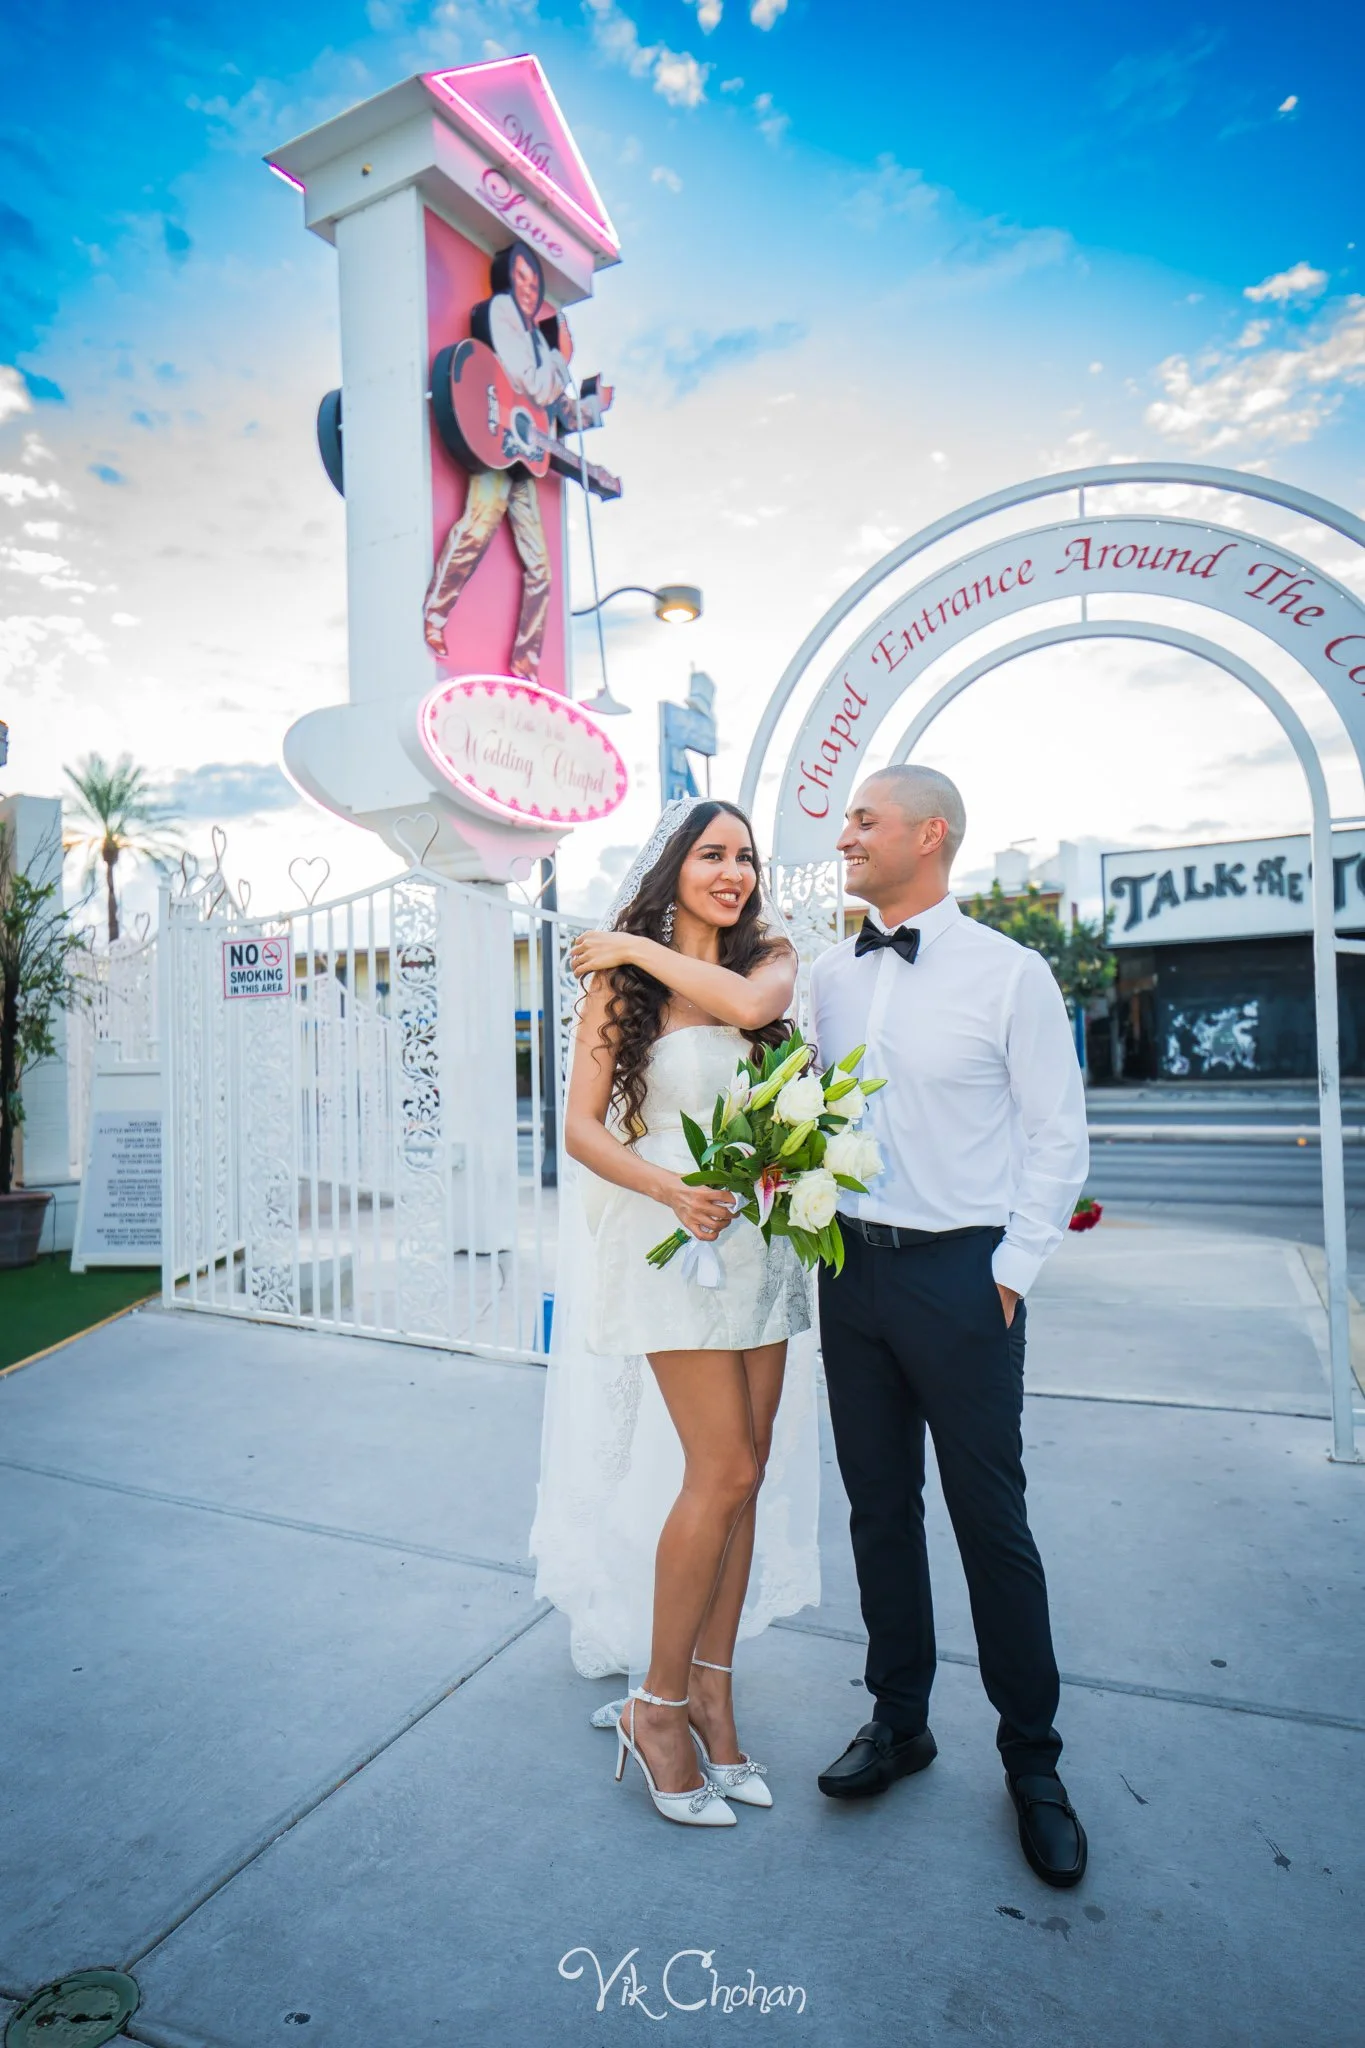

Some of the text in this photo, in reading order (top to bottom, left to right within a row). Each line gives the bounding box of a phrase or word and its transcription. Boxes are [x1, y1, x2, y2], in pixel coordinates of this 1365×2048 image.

[475, 168, 563, 258] Love
[797, 537, 1365, 819] Chapel Entrance Around The Co
[441, 713, 534, 790] Wedding
[542, 743, 606, 802] Chapel
[1110, 862, 1248, 932] TALK
[1253, 872, 1304, 905] THE
[230, 943, 259, 967] NO
[230, 968, 283, 984] SMOKING
[231, 983, 283, 995] IN THIS AREA
